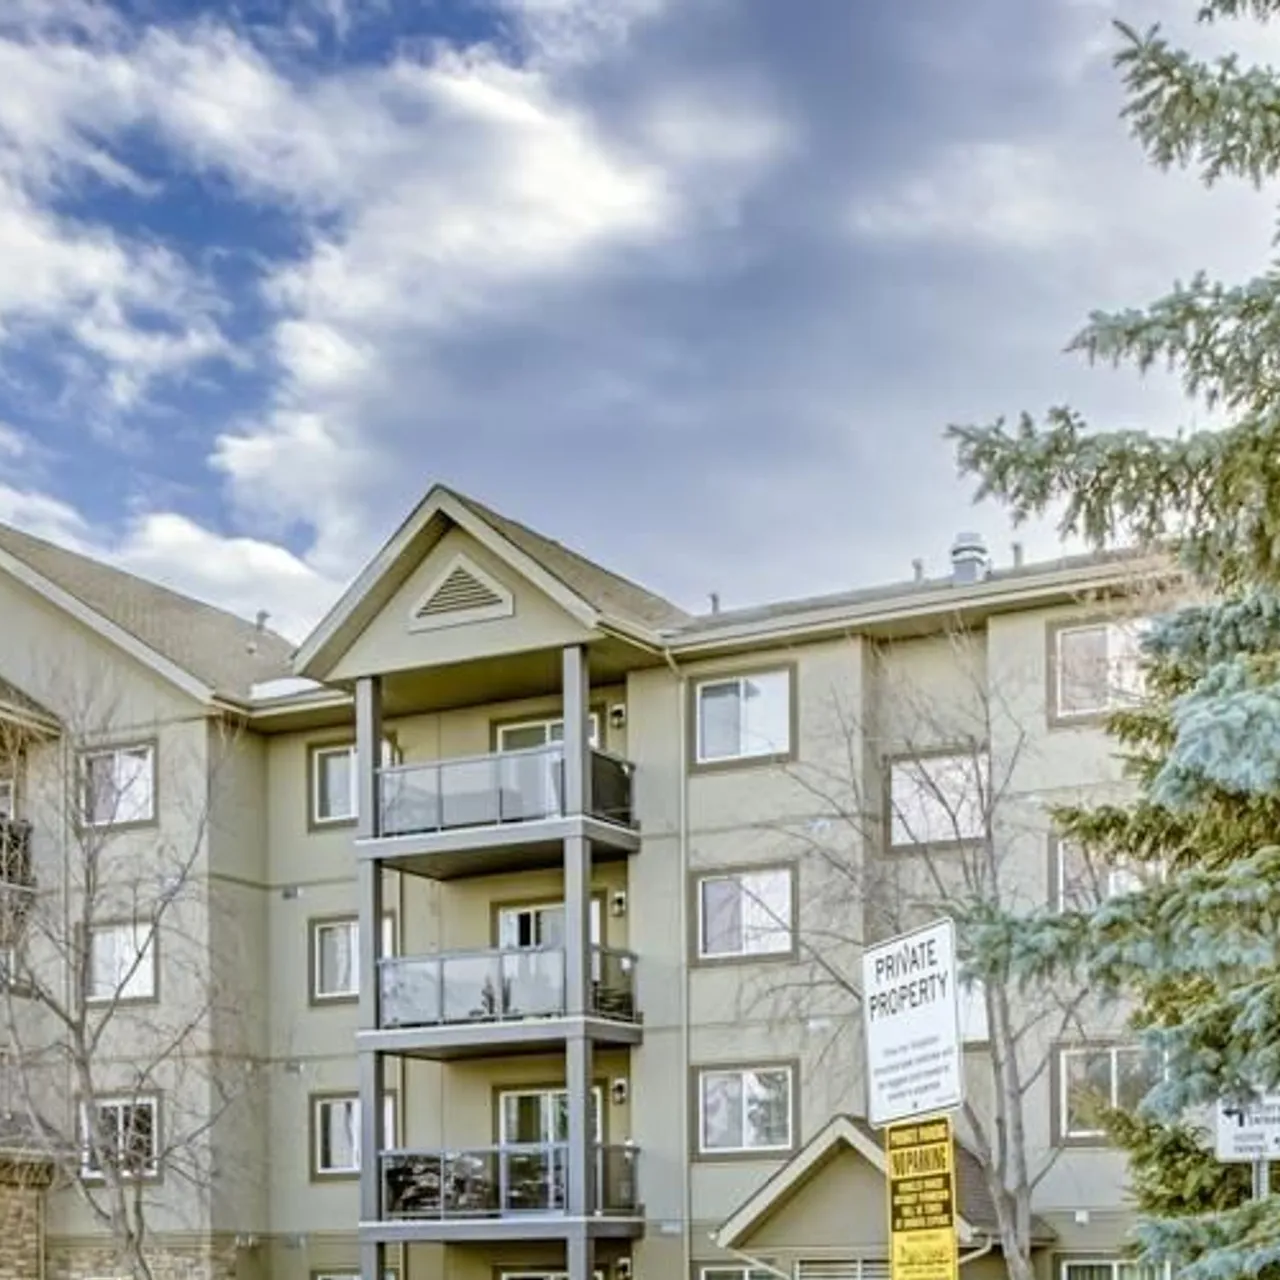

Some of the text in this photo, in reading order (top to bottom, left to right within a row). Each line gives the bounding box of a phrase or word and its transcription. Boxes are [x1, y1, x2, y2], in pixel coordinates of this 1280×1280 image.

[875, 939, 937, 983] PRIVATE
[869, 970, 948, 1022] PROPERTY
[906, 1144, 946, 1173] PARKING
